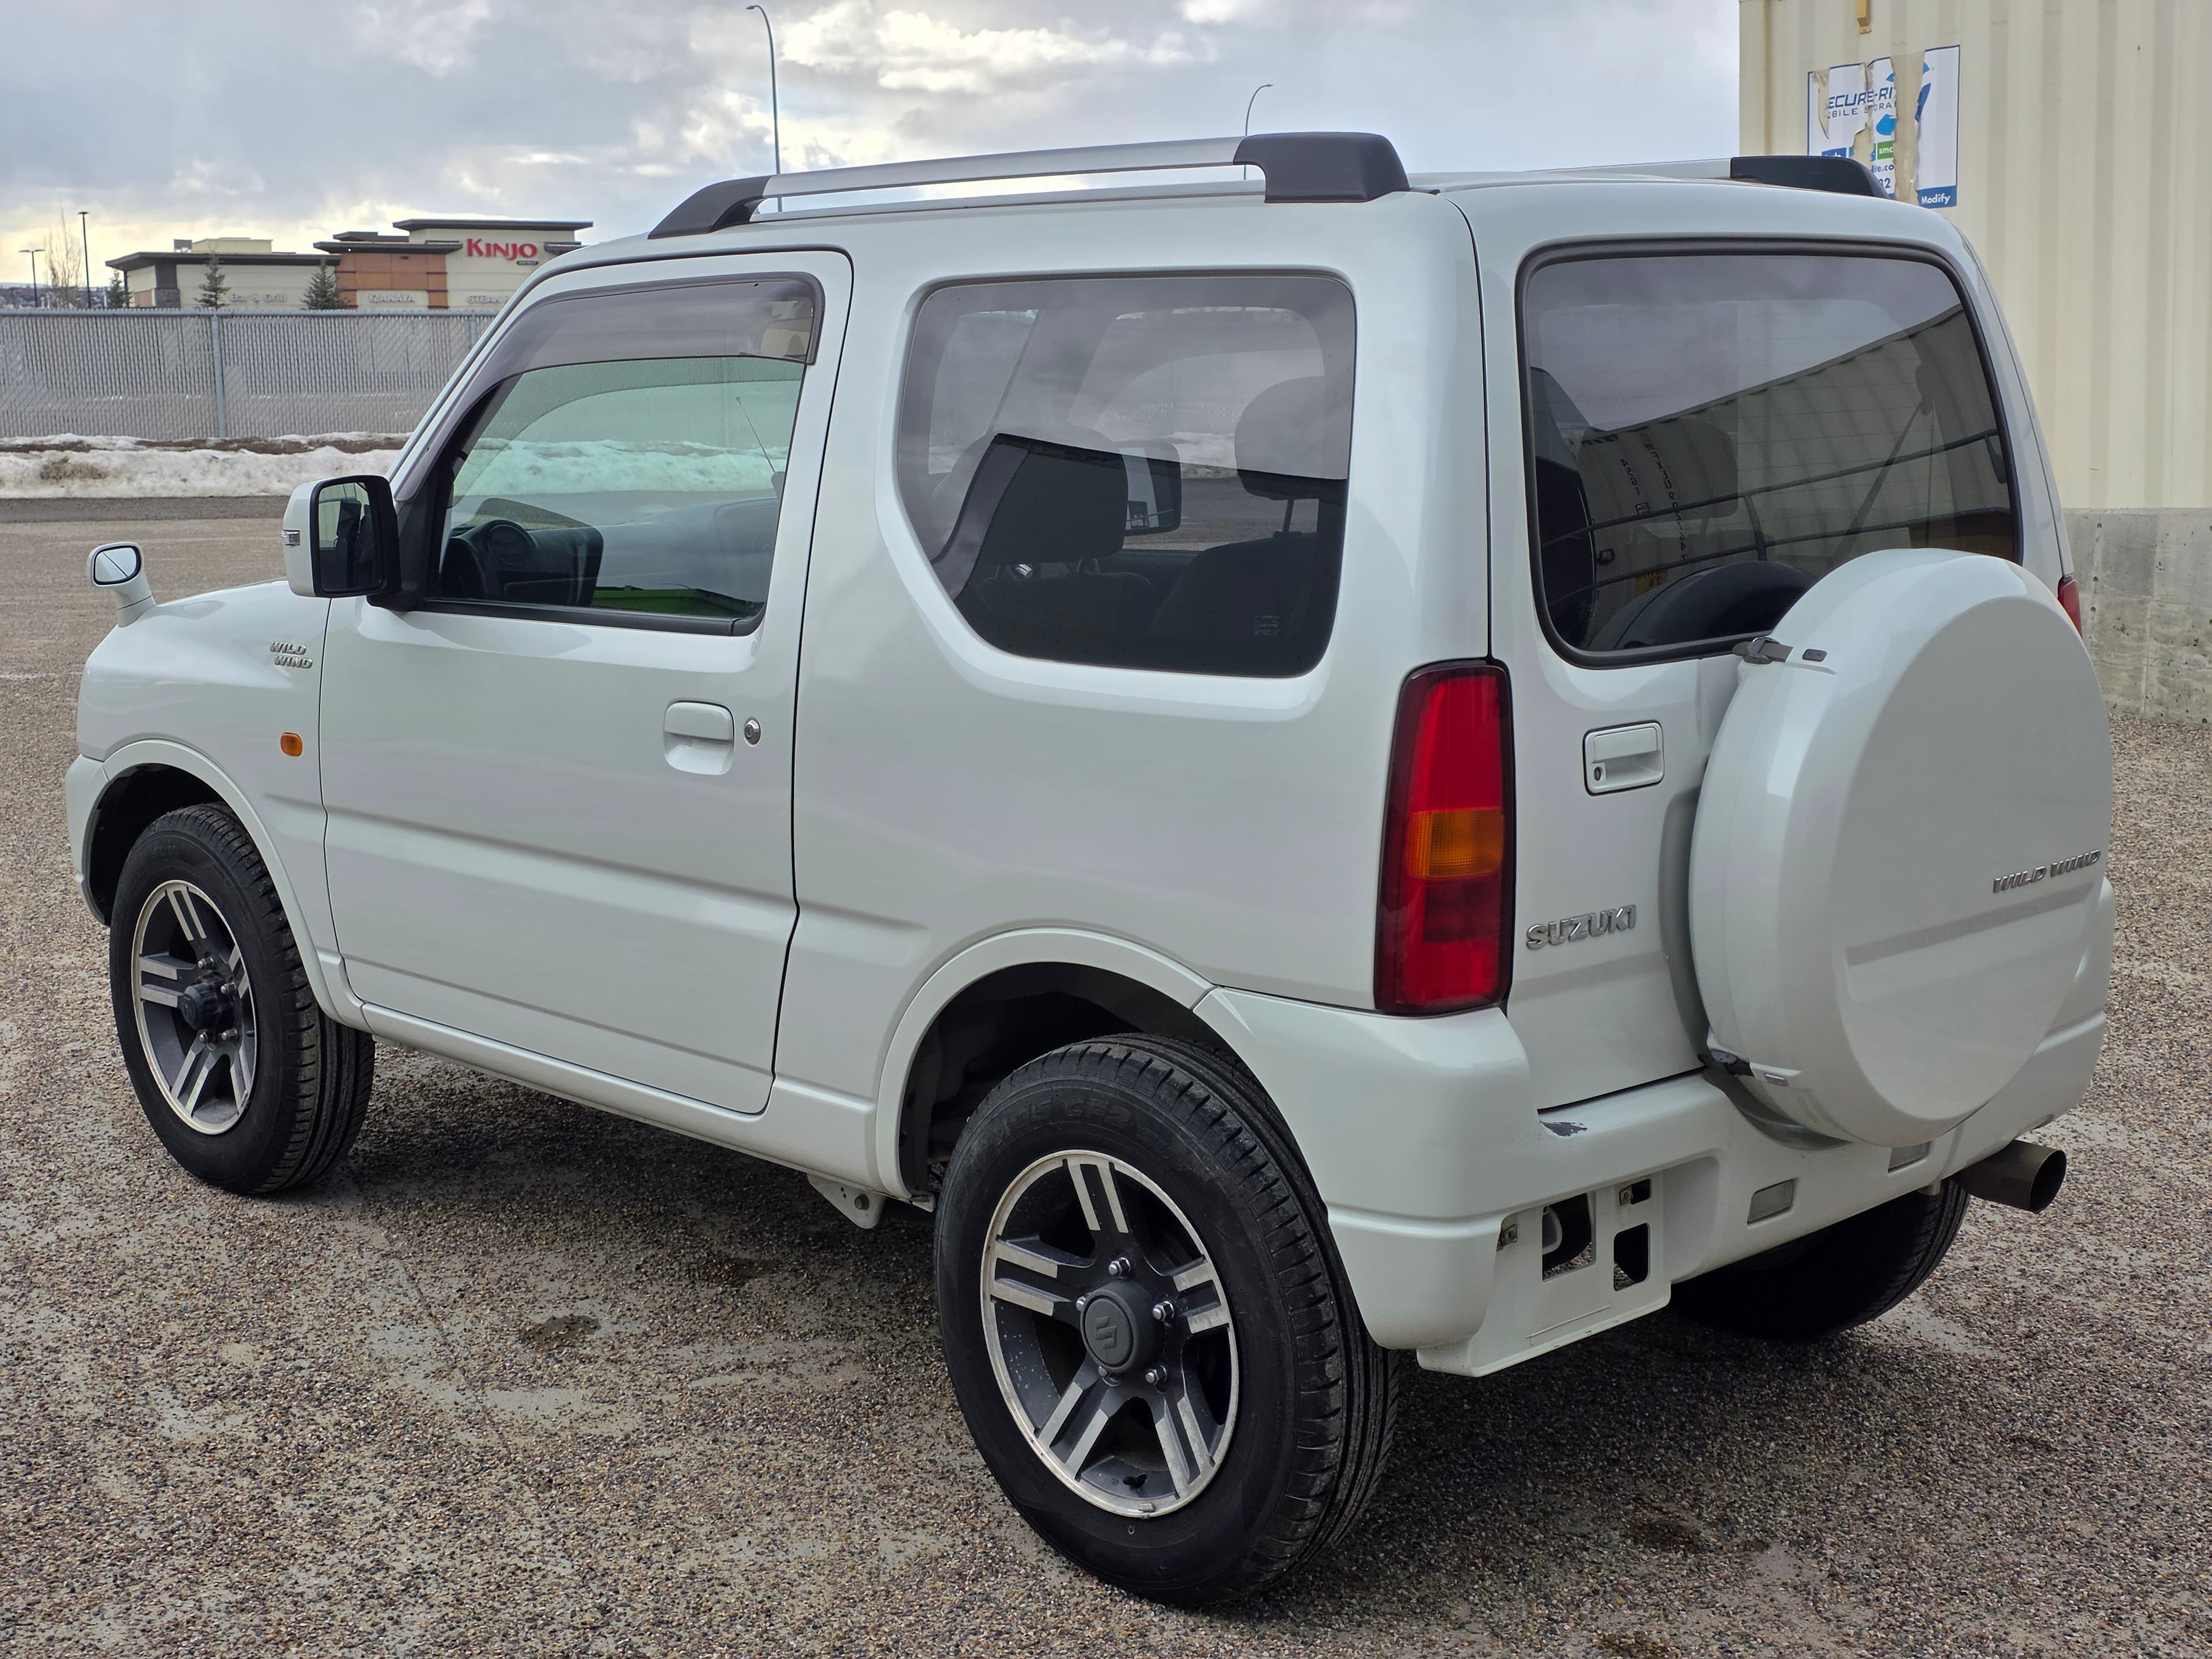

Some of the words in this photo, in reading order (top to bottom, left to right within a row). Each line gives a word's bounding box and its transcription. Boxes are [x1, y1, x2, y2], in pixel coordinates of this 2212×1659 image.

[1826, 86, 1896, 109] ECURE-RI
[1921, 193, 1950, 205] Modify
[467, 238, 538, 260] KINJO
[231, 293, 248, 302] Bar
[253, 293, 259, 302] &
[264, 293, 286, 302] Grill
[369, 294, 415, 304] IZAKAYA
[468, 294, 501, 304] STEAK
[270, 641, 306, 656] WILD
[274, 654, 313, 669] WIND
[1993, 866, 2047, 893] WILD
[2050, 850, 2101, 877] WIND
[1526, 904, 1637, 950] SUZUKI
